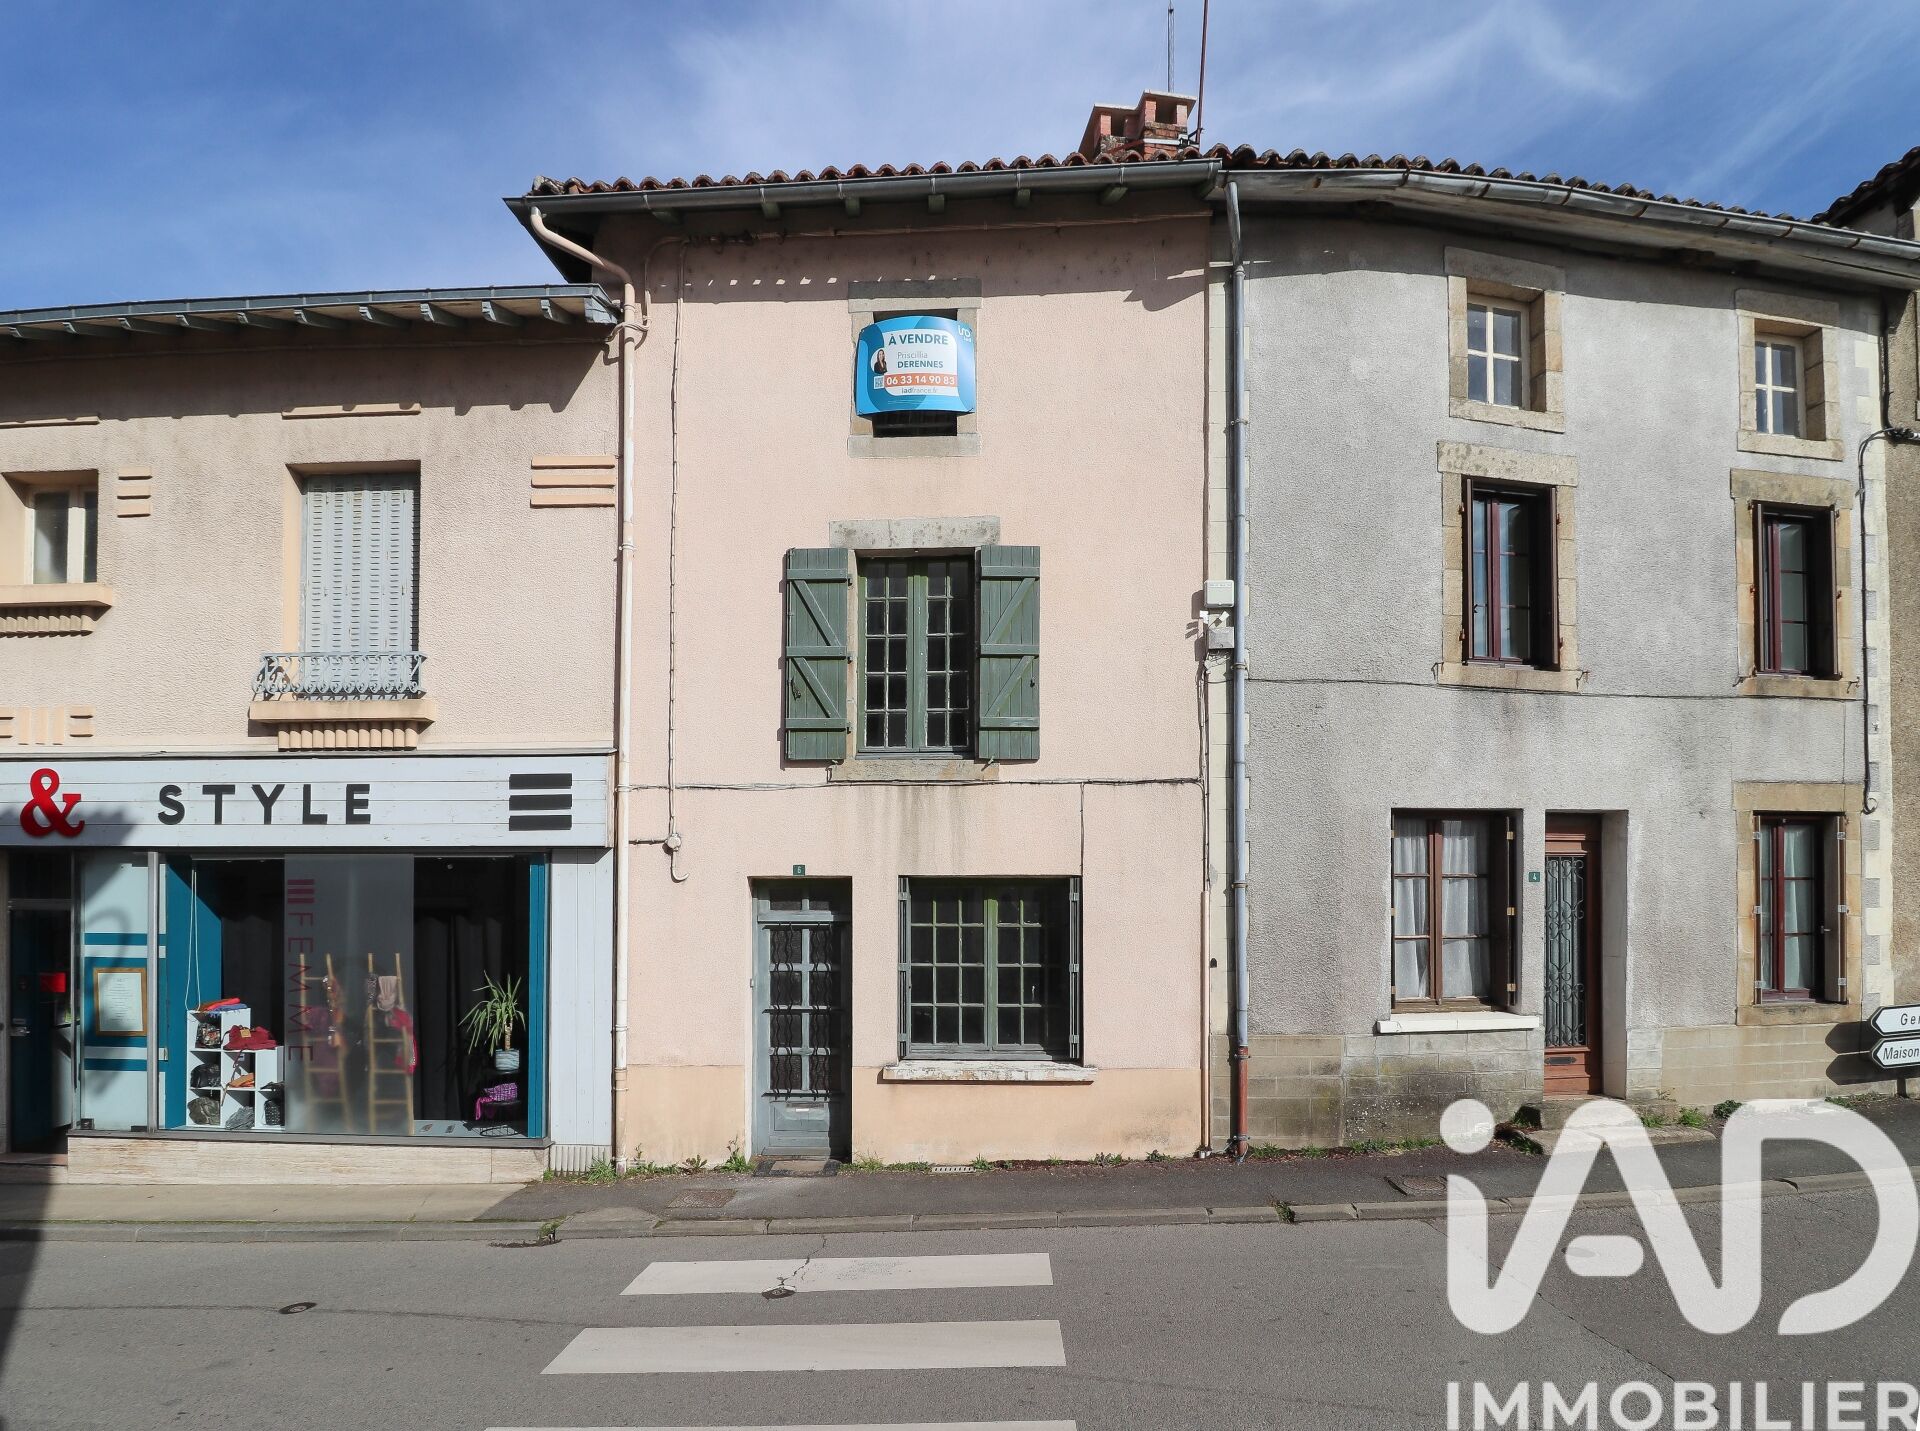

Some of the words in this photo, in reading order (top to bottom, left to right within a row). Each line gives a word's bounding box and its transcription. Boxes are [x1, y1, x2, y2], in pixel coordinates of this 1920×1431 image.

[889, 333, 897, 345] À
[899, 333, 949, 345] VENDRE
[897, 360, 944, 369] DERENNES
[886, 376, 899, 386] 06
[900, 375, 912, 385] 33
[914, 375, 927, 384] 14
[928, 375, 941, 384] 90
[943, 376, 955, 385] 83
[20, 768, 85, 837] &
[157, 784, 371, 825] STYLE
[288, 912, 314, 1062] FEMME
[1883, 1046, 1919, 1060] Maison
